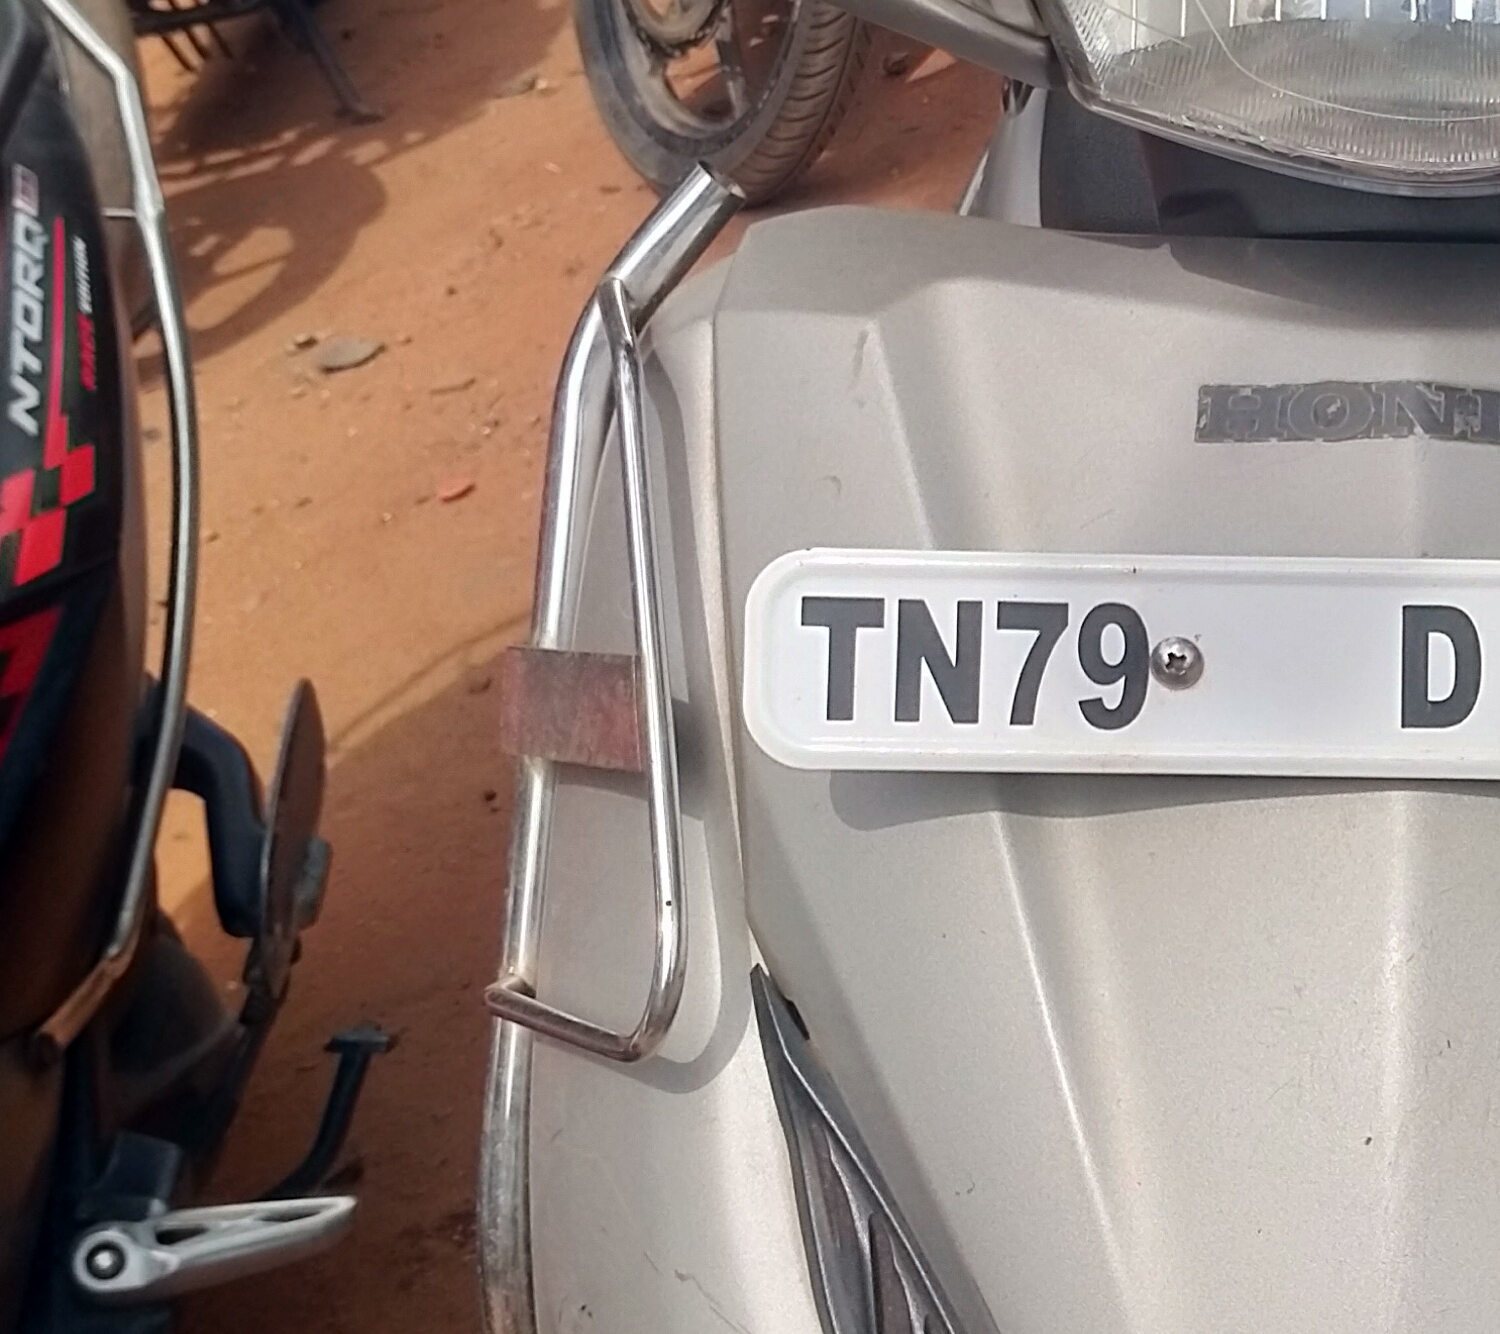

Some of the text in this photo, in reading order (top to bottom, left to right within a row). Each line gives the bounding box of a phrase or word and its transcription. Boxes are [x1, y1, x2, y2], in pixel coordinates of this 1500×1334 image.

[8, 214, 48, 436] NTORQ
[800, 595, 1151, 731] TN79
[1401, 604, 1482, 729] D
